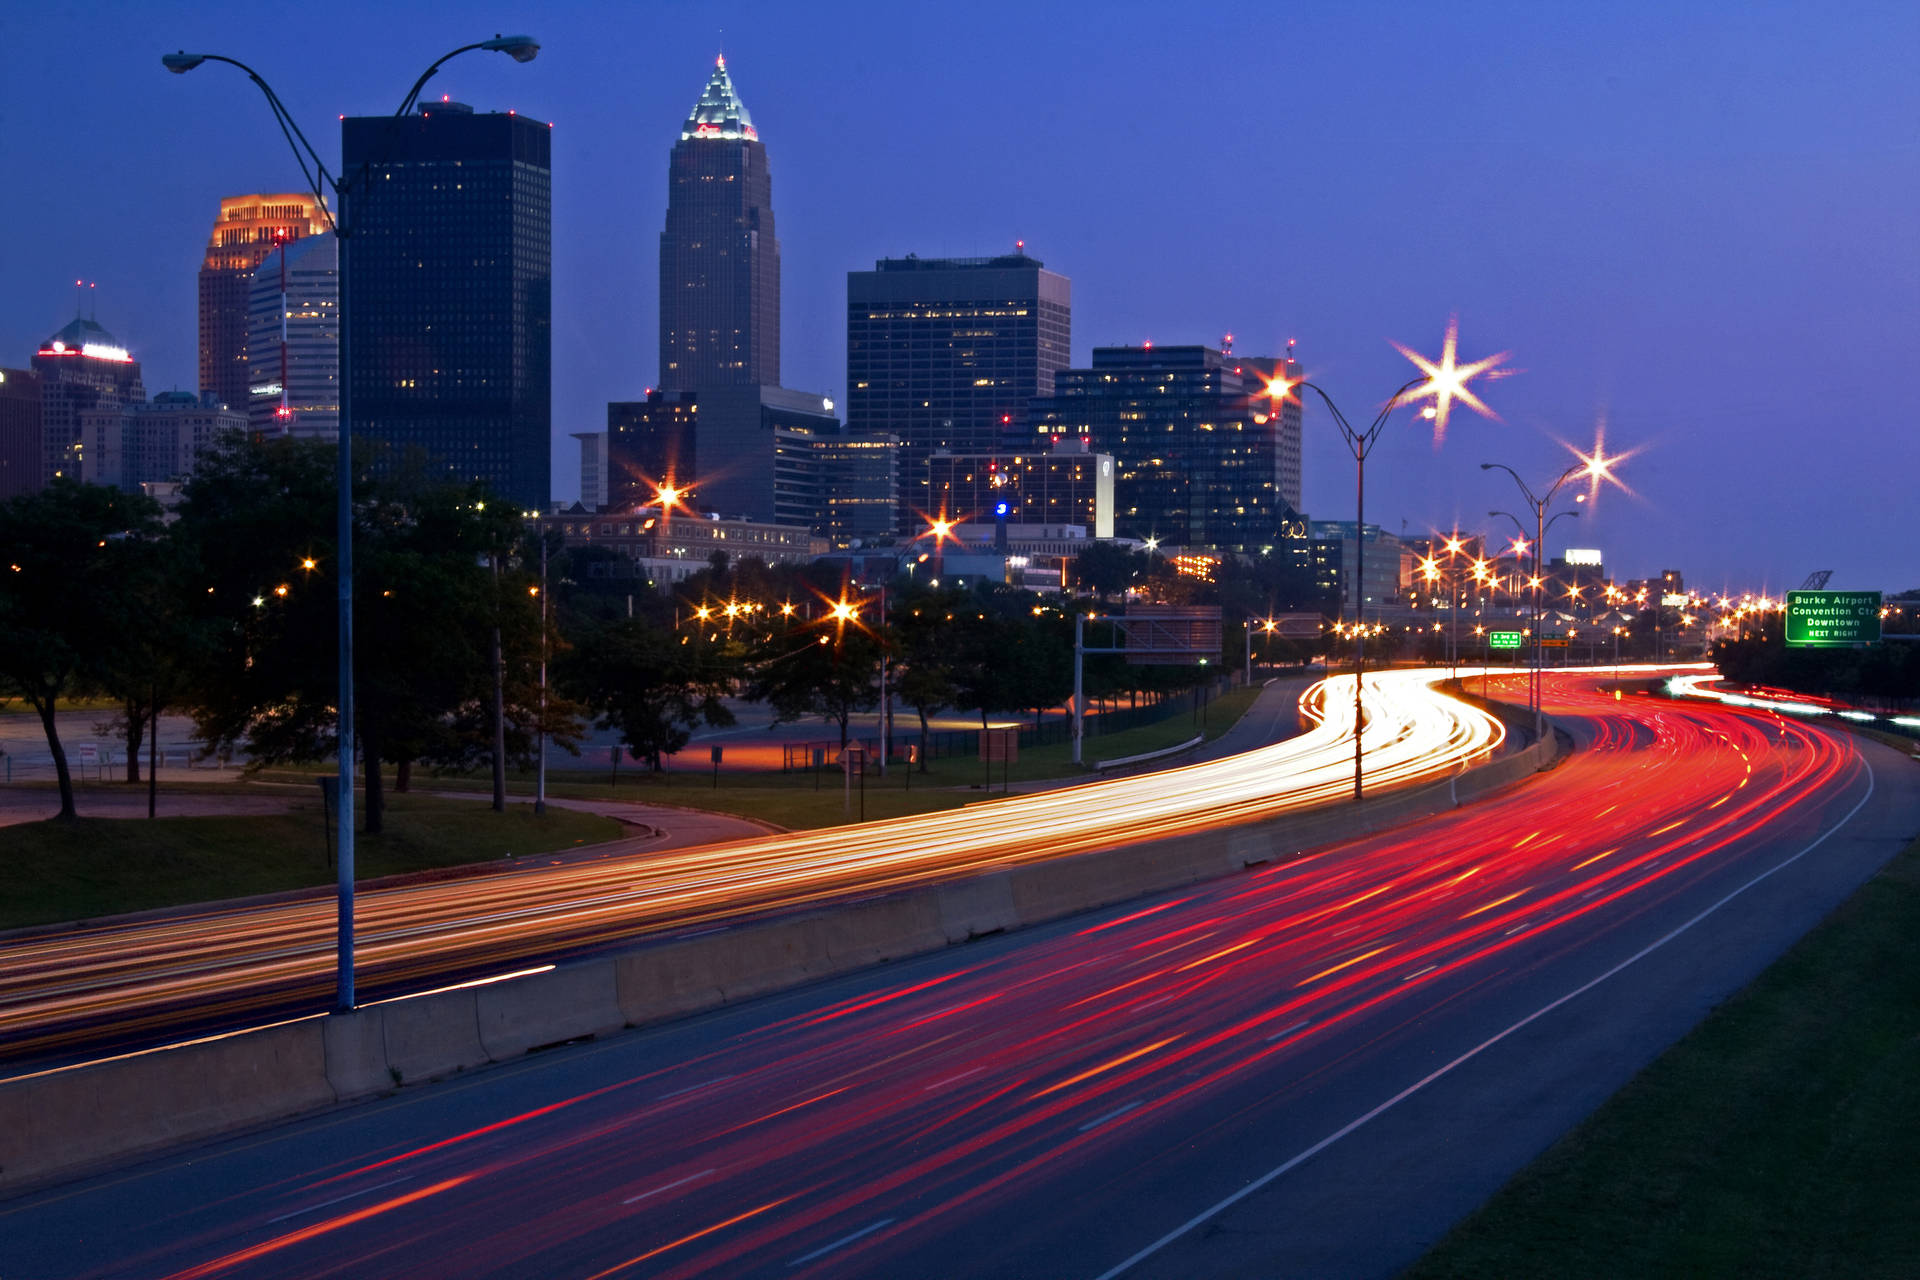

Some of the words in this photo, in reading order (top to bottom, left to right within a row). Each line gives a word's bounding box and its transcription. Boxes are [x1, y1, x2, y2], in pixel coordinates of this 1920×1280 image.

[1795, 596, 1826, 604] Burke
[1833, 596, 1873, 606] Airport
[1792, 607, 1851, 616] Convention
[1858, 607, 1874, 616] Ctr
[1807, 618, 1860, 627] Downtown
